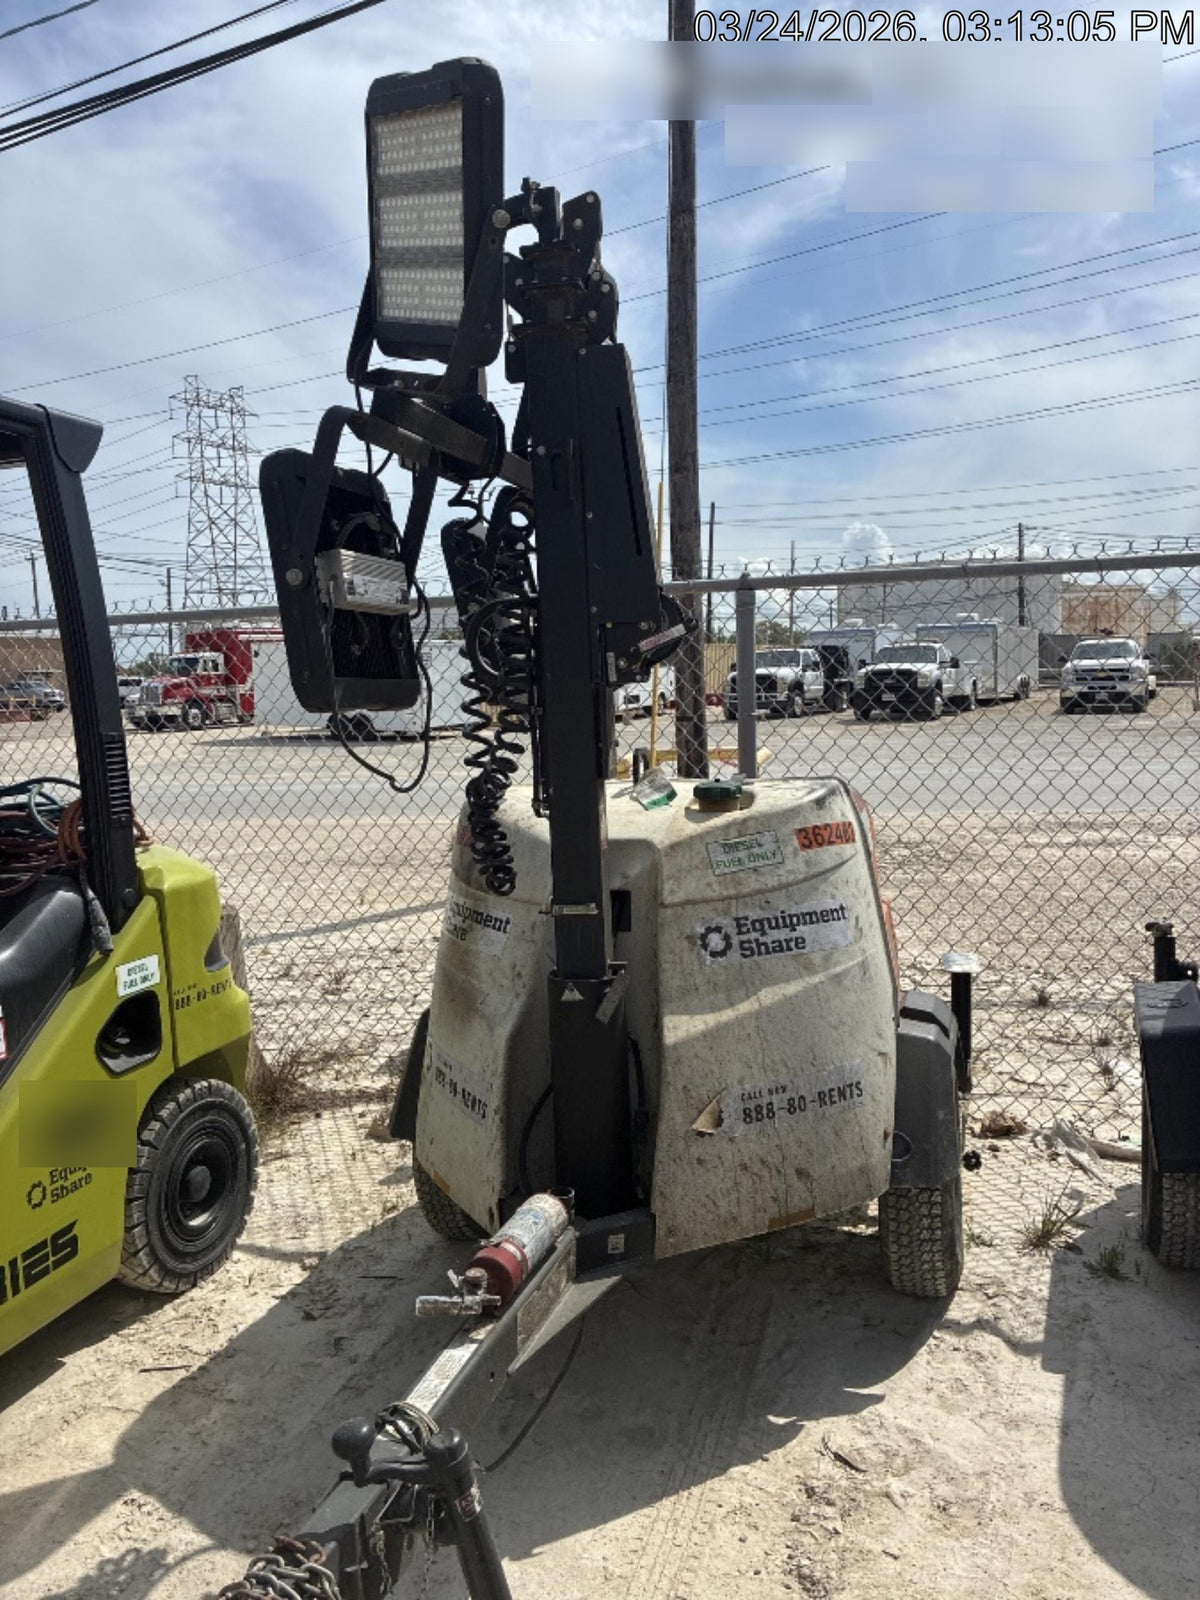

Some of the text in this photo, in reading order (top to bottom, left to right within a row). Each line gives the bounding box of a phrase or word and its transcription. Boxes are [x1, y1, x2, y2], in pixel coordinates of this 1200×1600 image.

[748, 850, 776, 863] ONLY
[733, 903, 847, 936] Equipment
[739, 935, 807, 959] Share
[742, 1080, 864, 1125] 888-80-RENTS
[50, 1172, 93, 1204] Share
